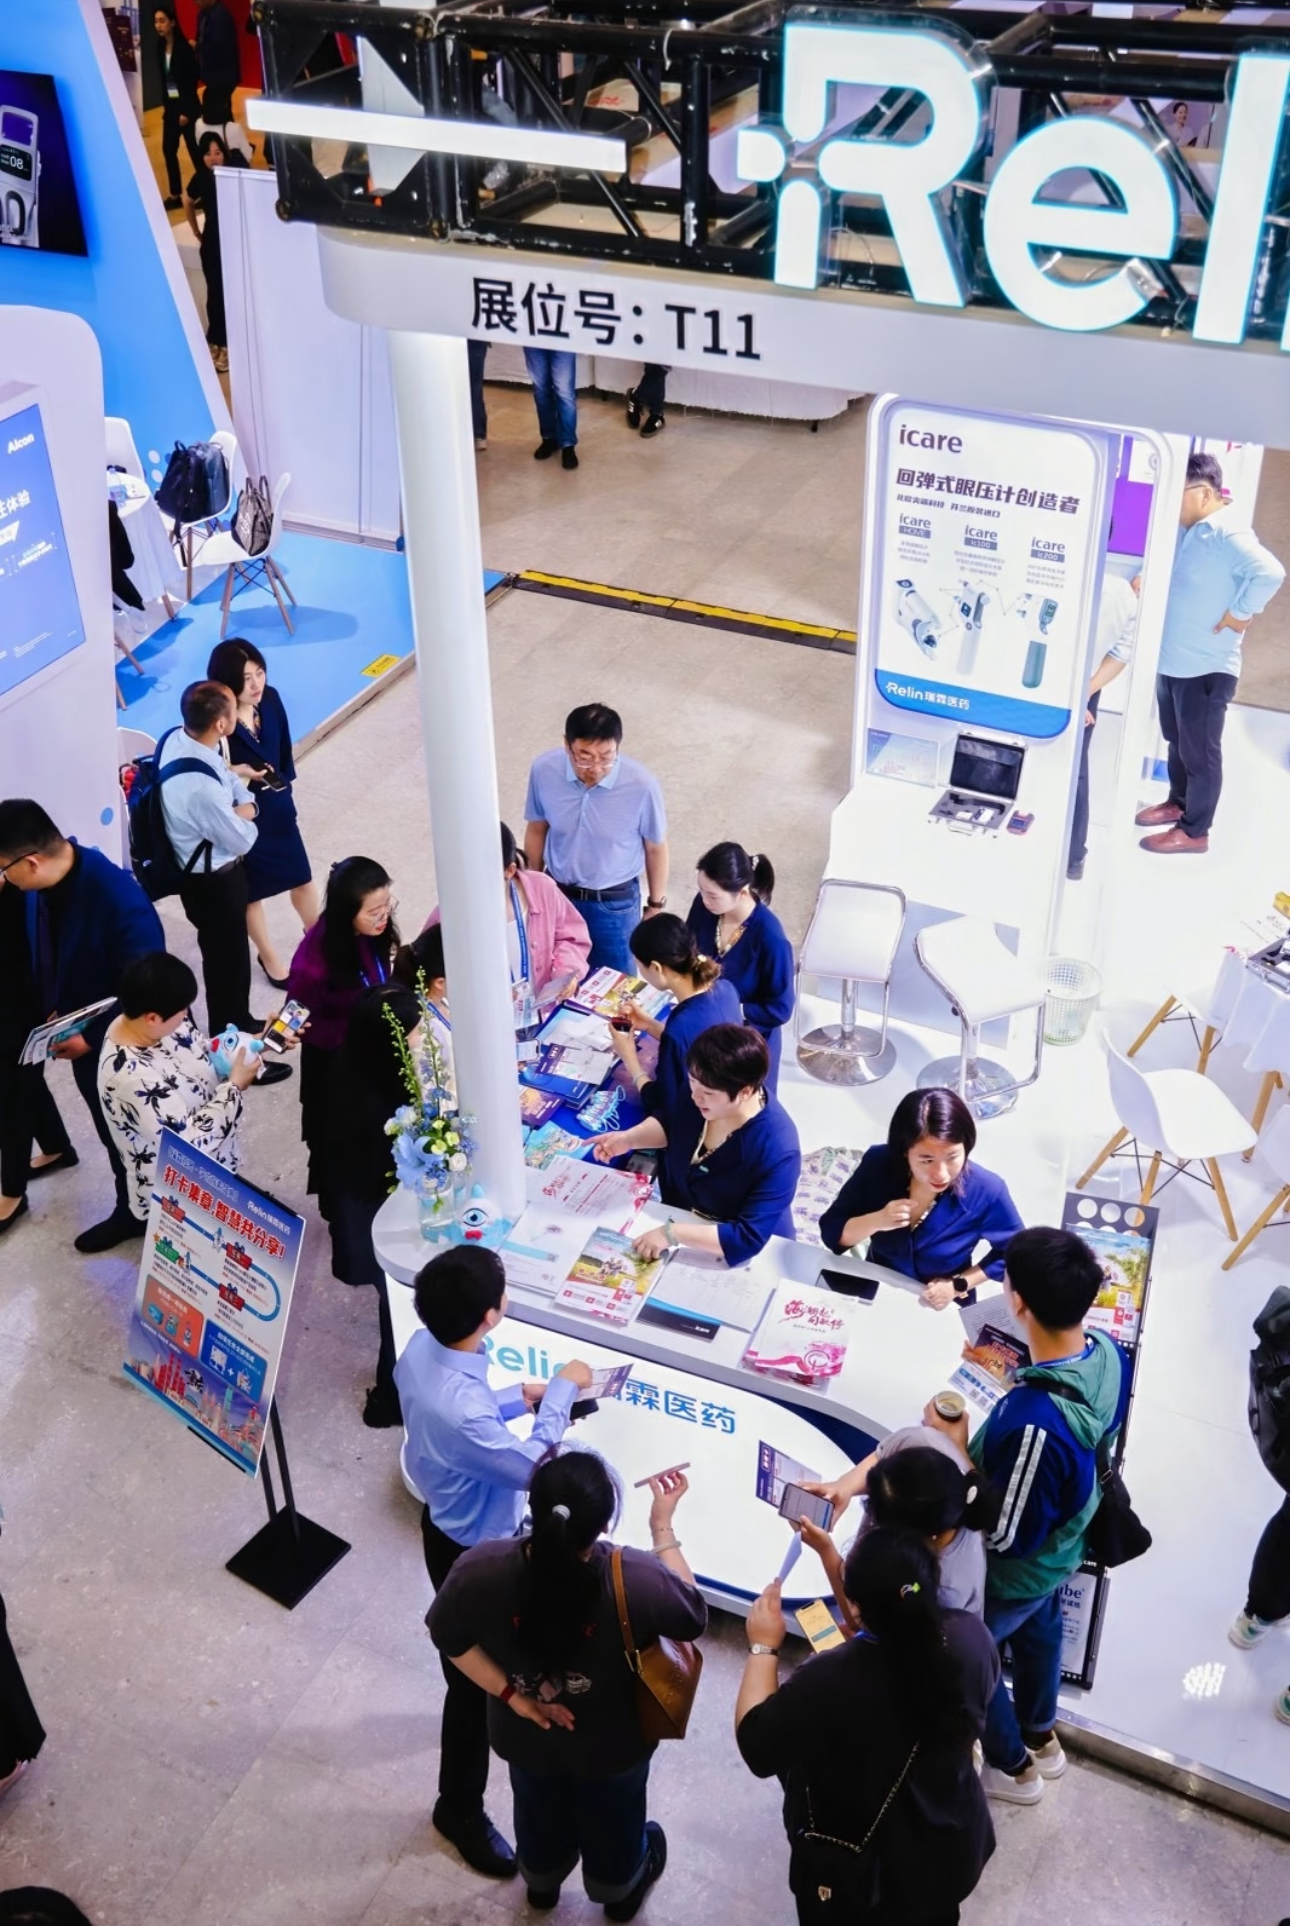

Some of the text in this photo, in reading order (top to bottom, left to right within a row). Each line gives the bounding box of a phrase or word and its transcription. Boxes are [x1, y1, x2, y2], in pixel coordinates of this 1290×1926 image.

[736, 22, 1290, 350] Rel
[8, 433, 35, 455] Alcon
[900, 424, 963, 454] icare
[896, 468, 1080, 515] 回弹式眼压计创造者
[899, 513, 932, 529] icare
[965, 524, 998, 541] icare
[1031, 536, 1066, 553] icare
[886, 682, 970, 711] Relin 瑞霖医药
[482, 1335, 566, 1380] eli
[612, 1378, 736, 1435] 霖医药
